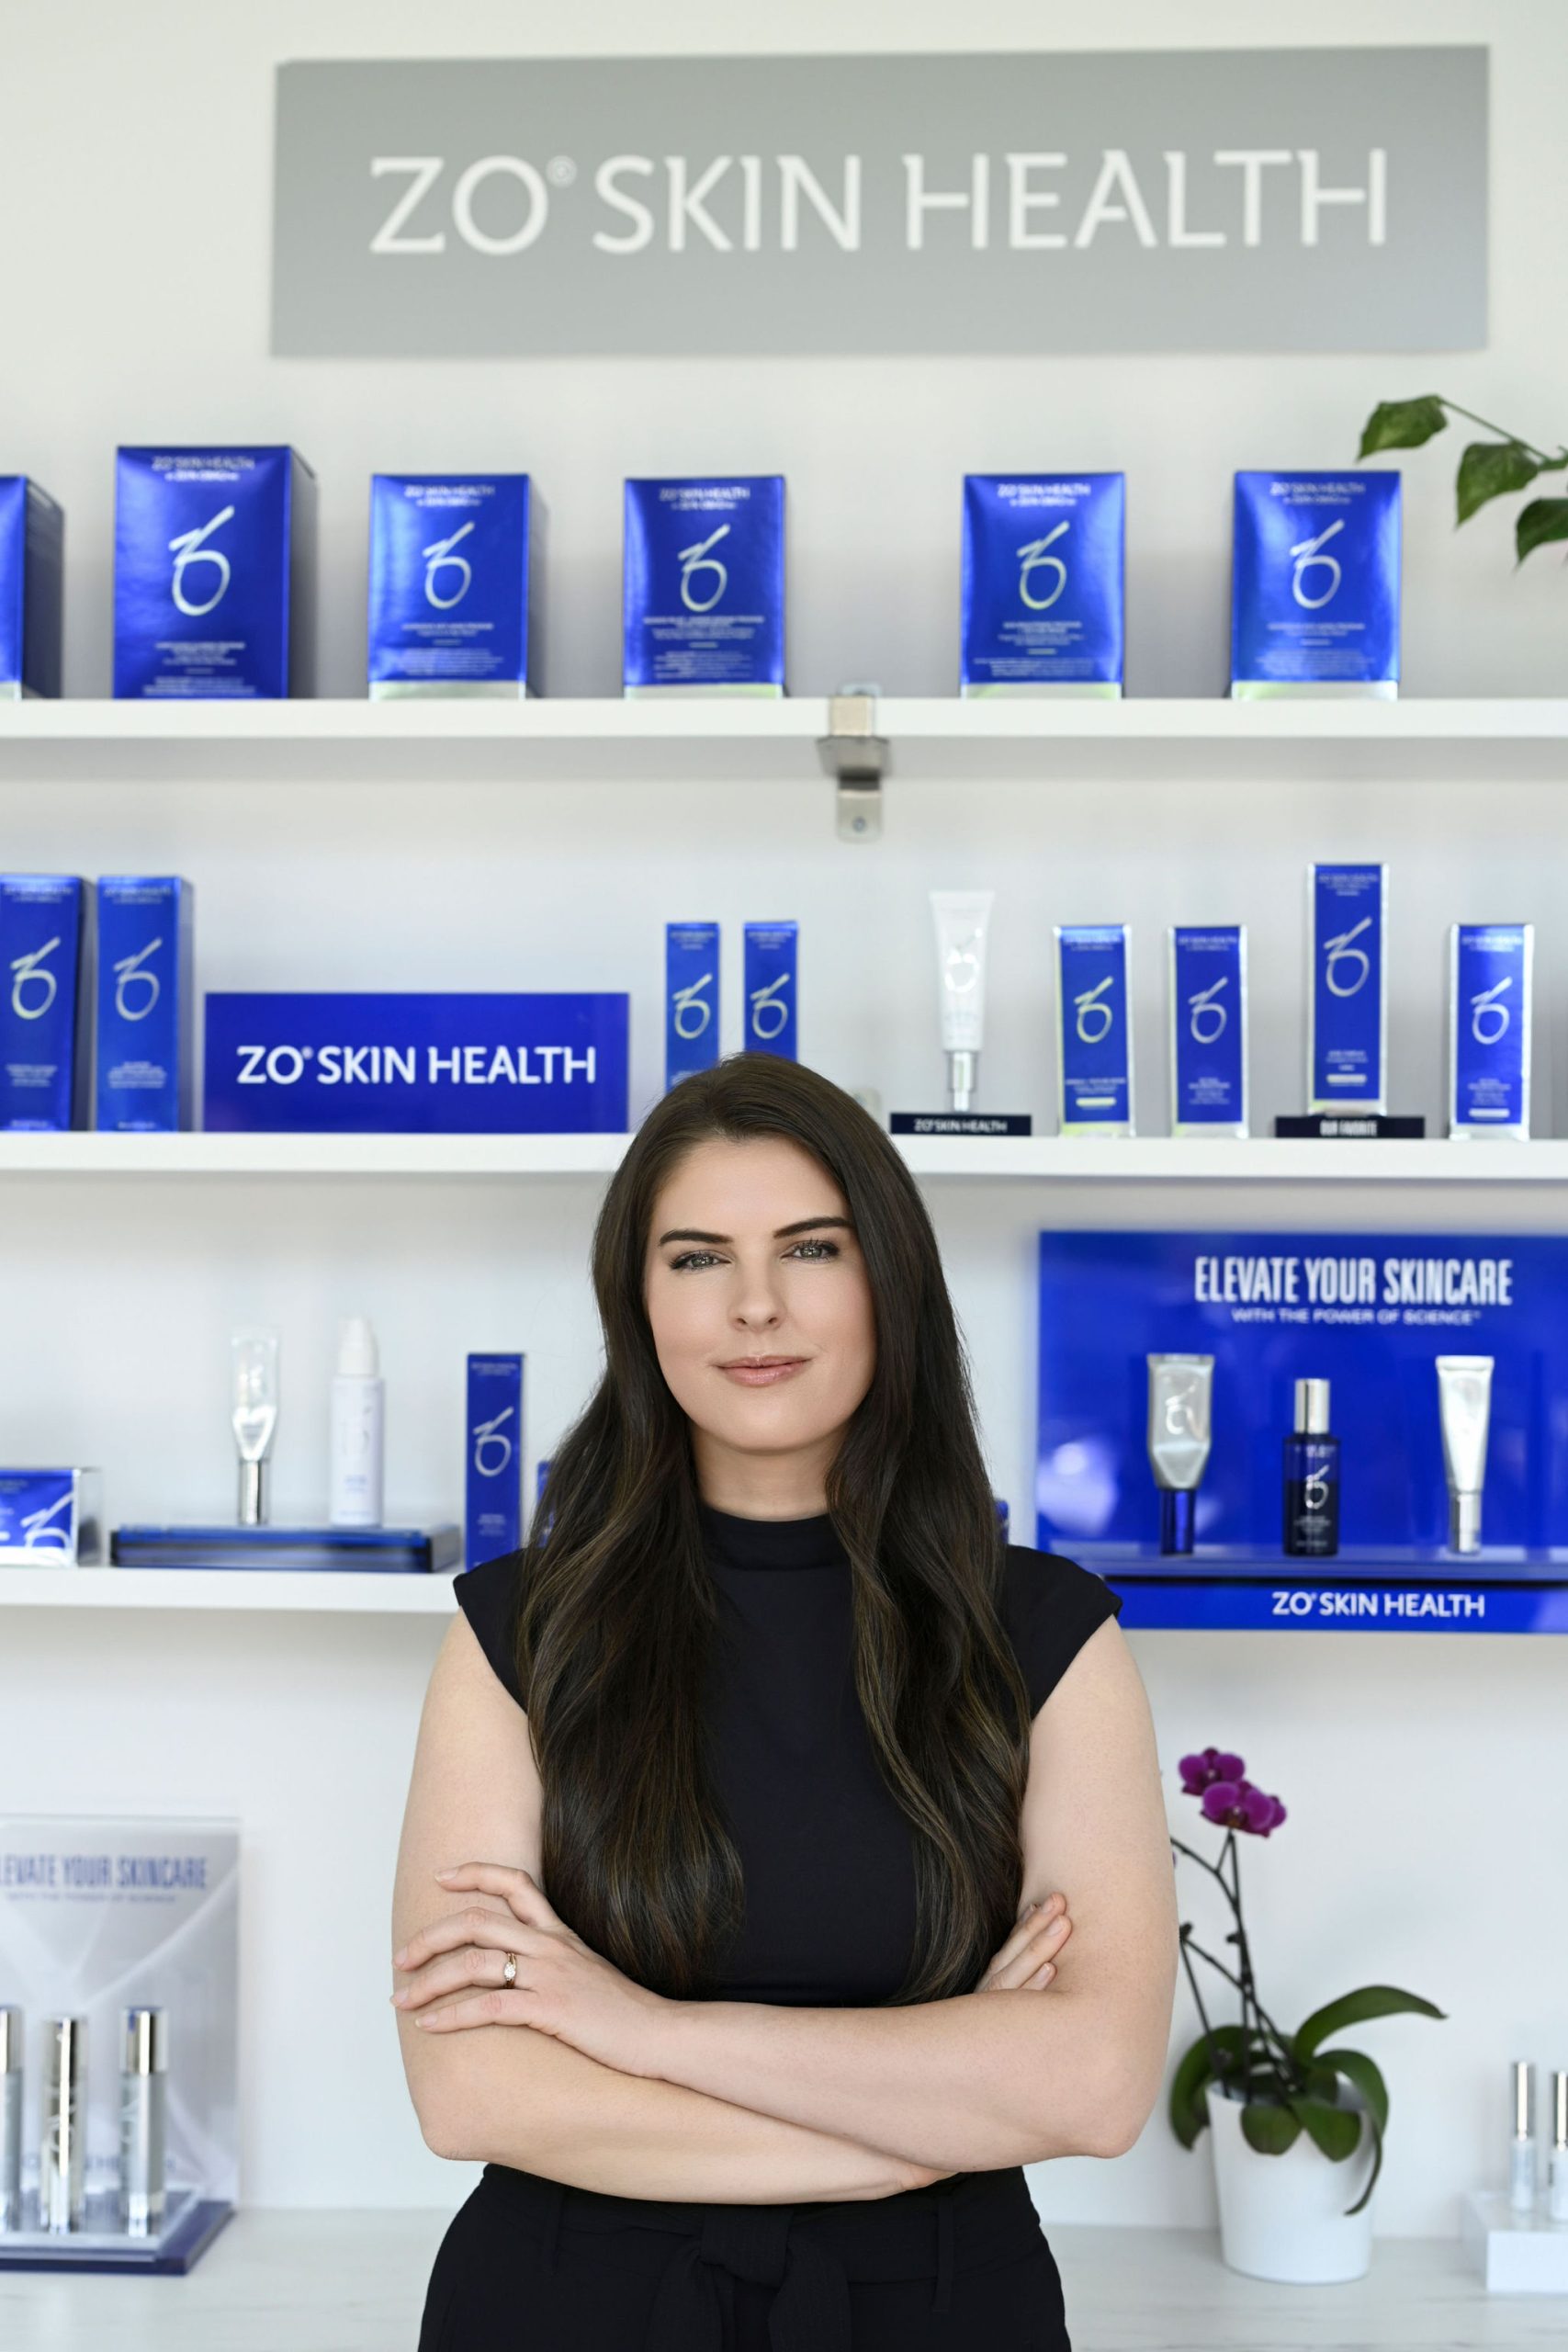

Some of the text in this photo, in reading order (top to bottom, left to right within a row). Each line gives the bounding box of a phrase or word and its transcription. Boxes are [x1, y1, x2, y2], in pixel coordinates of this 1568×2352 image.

[592, 154, 862, 254] SKIN
[902, 149, 1387, 251] HEALTH
[317, 1046, 416, 1084] SKIN
[427, 1046, 596, 1084] HEALTH
[935, 1118, 961, 1133] SKIN
[962, 1118, 1008, 1134] HEALTH
[1194, 1256, 1513, 1306] ELEVATE YOUR SKINCARE
[1231, 1307, 1275, 1323] WITH
[1277, 1307, 1309, 1324] THE
[1313, 1308, 1374, 1325] POWER
[1377, 1309, 1400, 1325] OF
[1319, 1592, 1378, 1616] SKIN
[1383, 1593, 1485, 1618] HEALTH
[117, 1855, 207, 1891] SKINCARE
